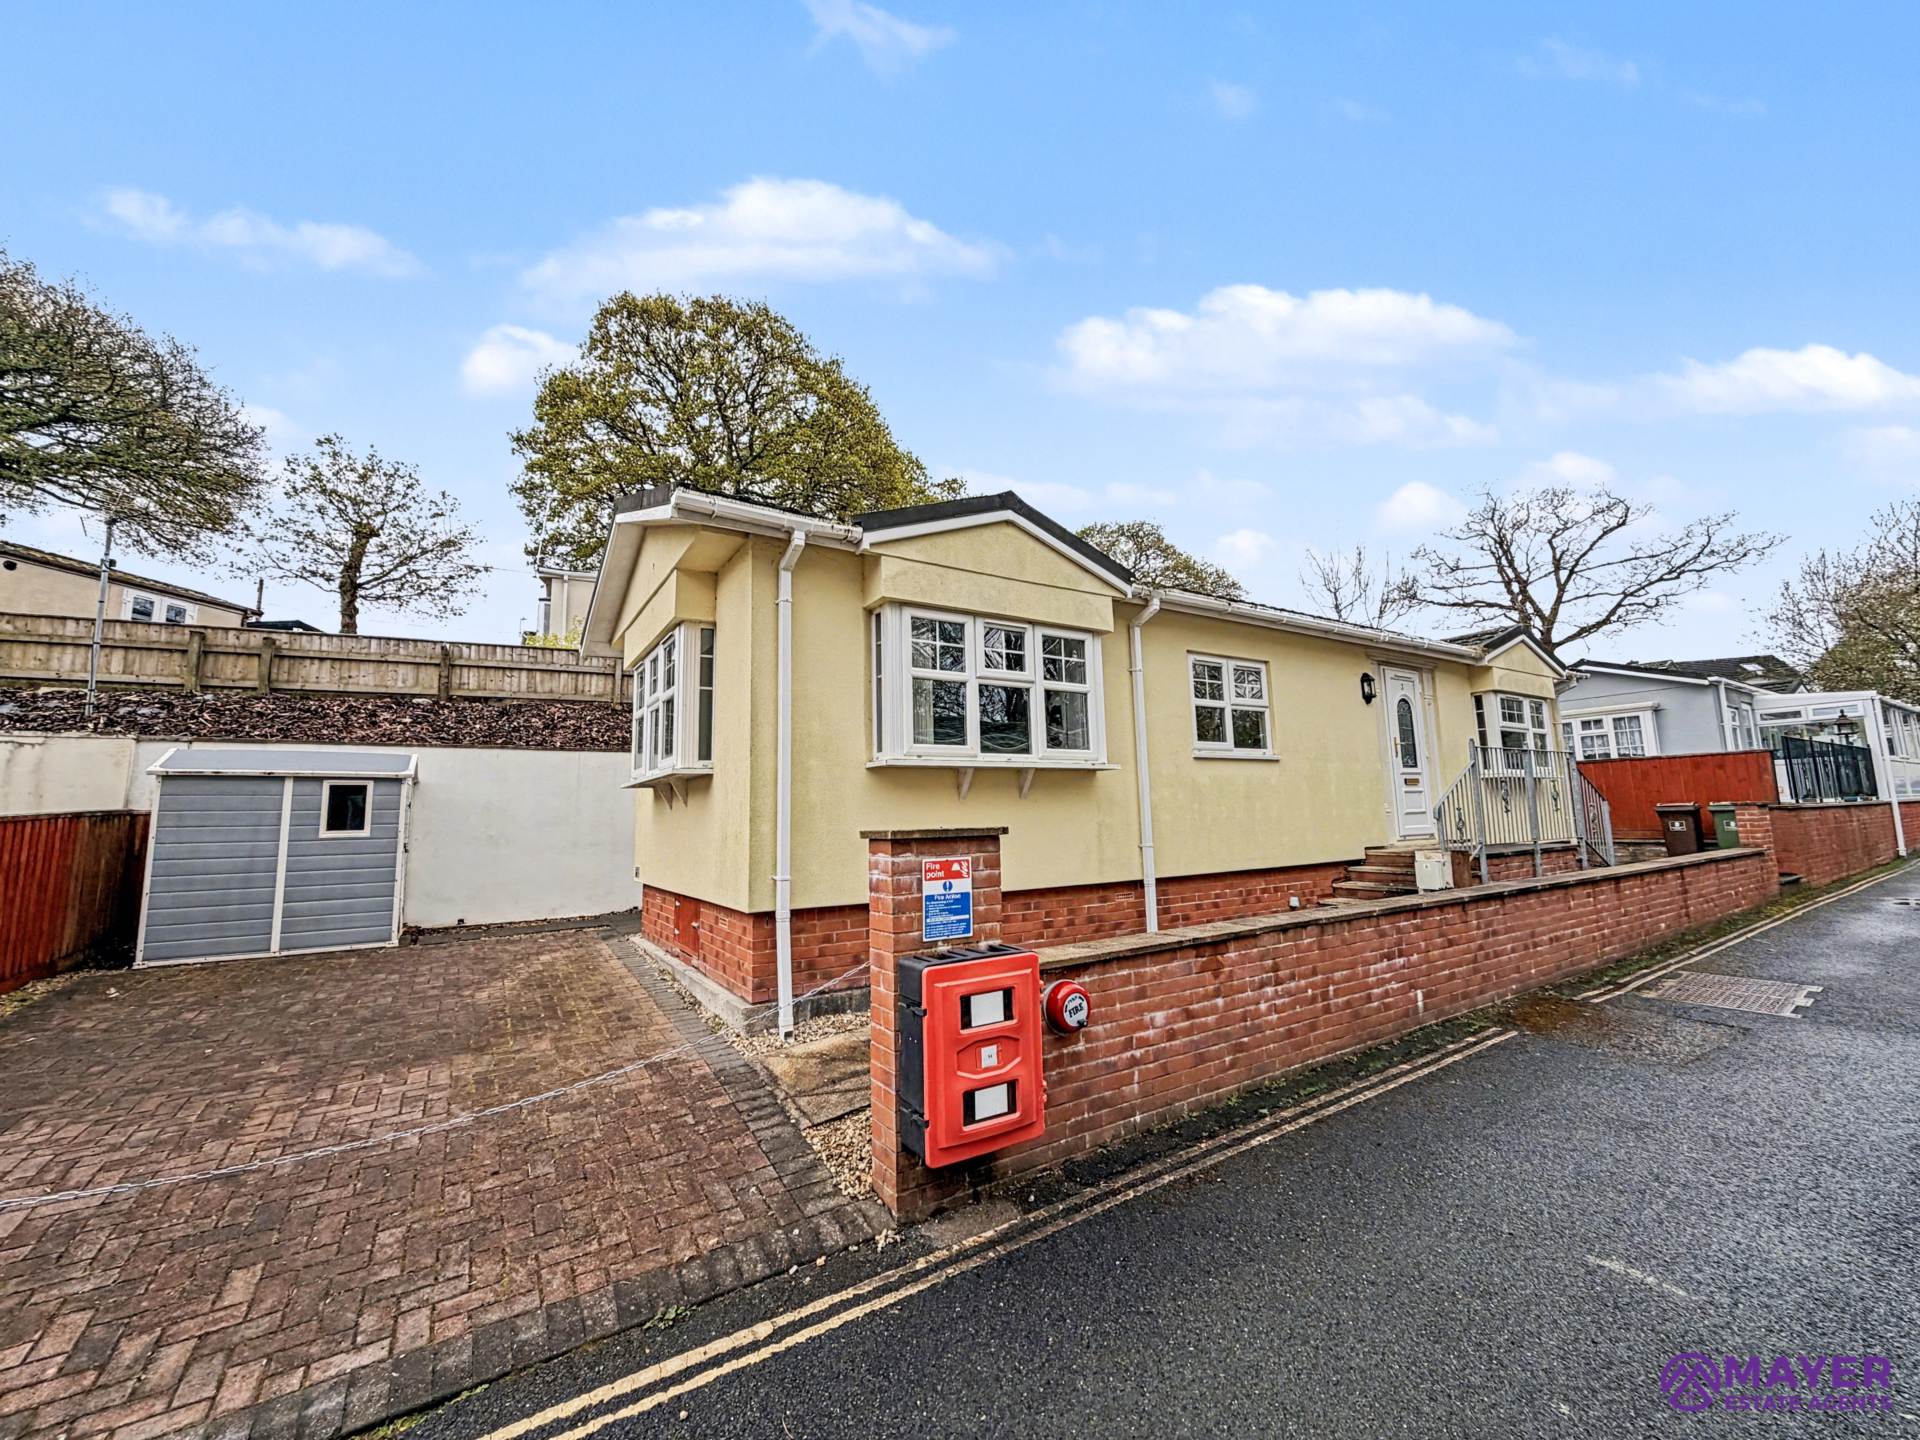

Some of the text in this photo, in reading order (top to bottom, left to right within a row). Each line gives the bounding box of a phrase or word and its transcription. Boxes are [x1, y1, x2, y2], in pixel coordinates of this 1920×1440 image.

[926, 862, 940, 870] Fire
[926, 870, 945, 879] point
[1068, 1002, 1084, 1018] FIRE
